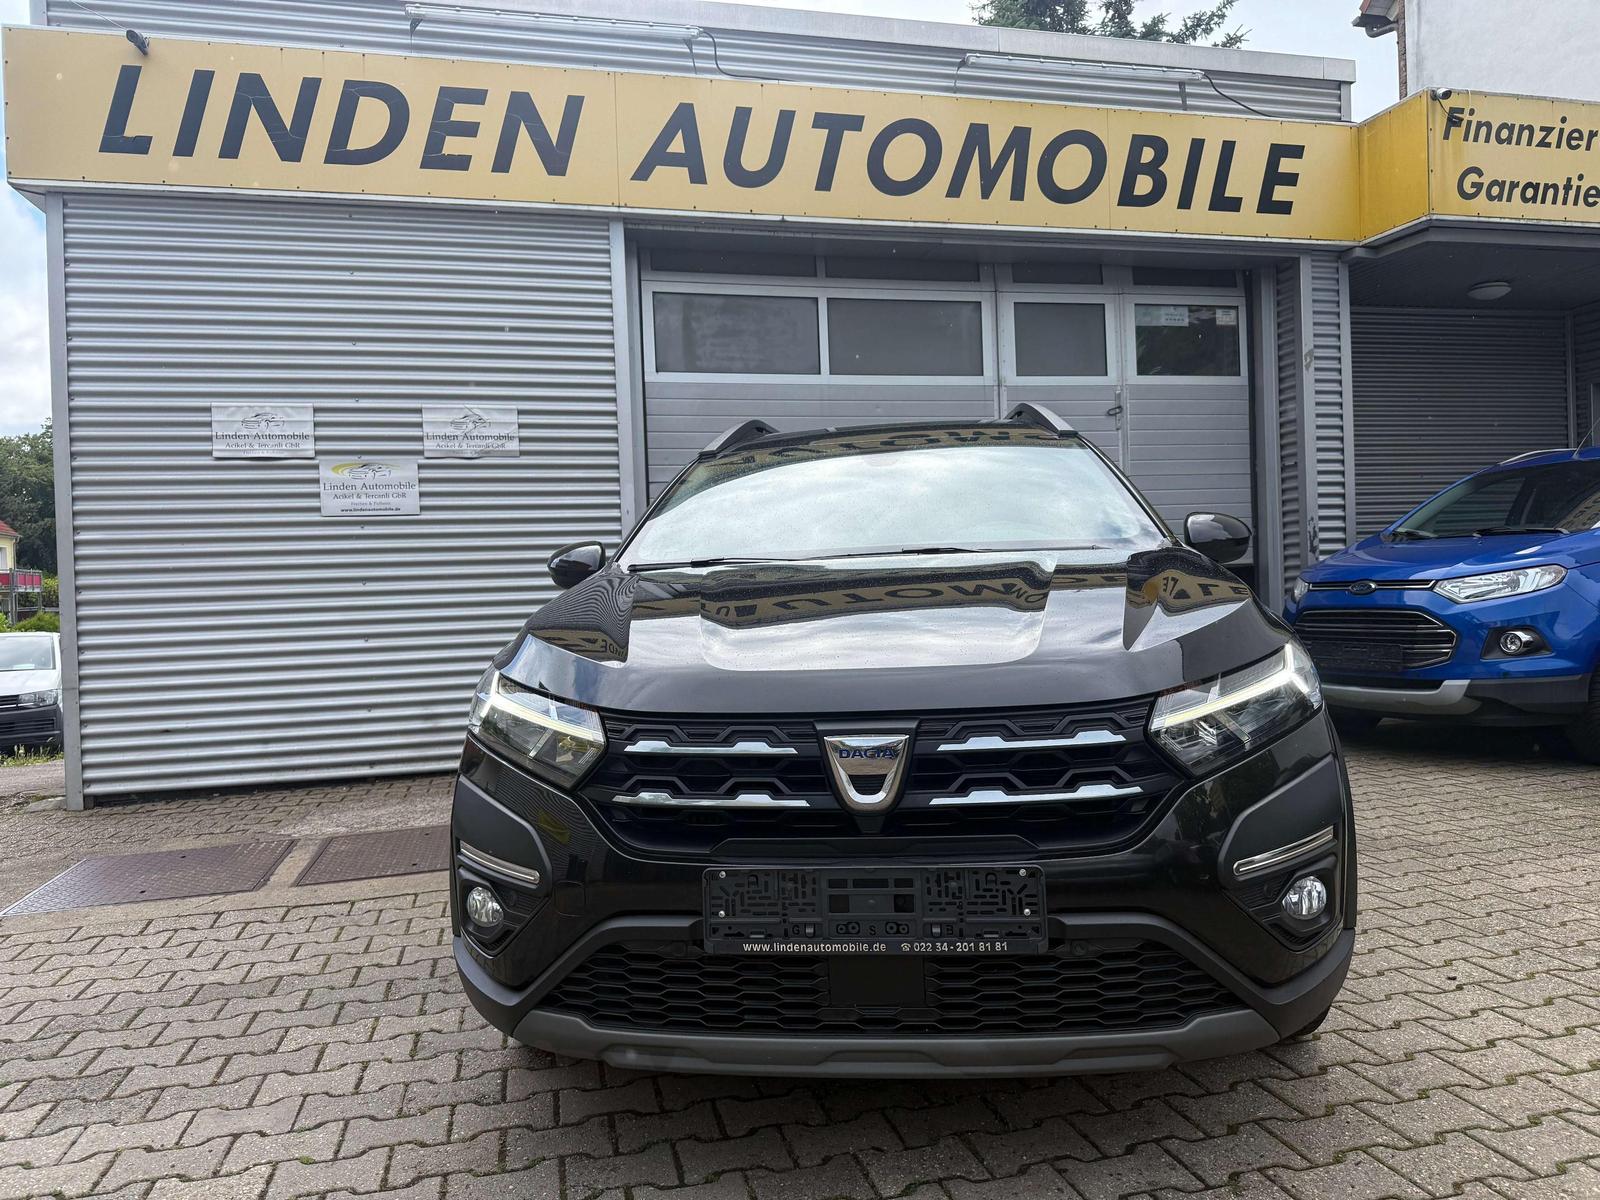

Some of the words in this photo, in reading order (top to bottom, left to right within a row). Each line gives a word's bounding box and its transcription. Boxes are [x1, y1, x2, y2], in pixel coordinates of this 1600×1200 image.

[1442, 106, 1599, 152] Finanzier
[98, 64, 585, 177] LINDEN
[629, 101, 1306, 216] AUTOMOBILE
[1456, 165, 1600, 208] Garantie
[215, 431, 250, 440] Linden
[253, 431, 310, 440] Automobile
[426, 432, 459, 441] Linden
[462, 432, 515, 442] Automobile
[323, 482, 357, 491] Linden
[360, 481, 417, 490] Automobile
[838, 749, 895, 760] DACIA
[742, 942, 887, 952] www.lindenautomobile.de
[913, 942, 933, 952] 022
[978, 942, 991, 952] 81
[994, 941, 1008, 951] 81
